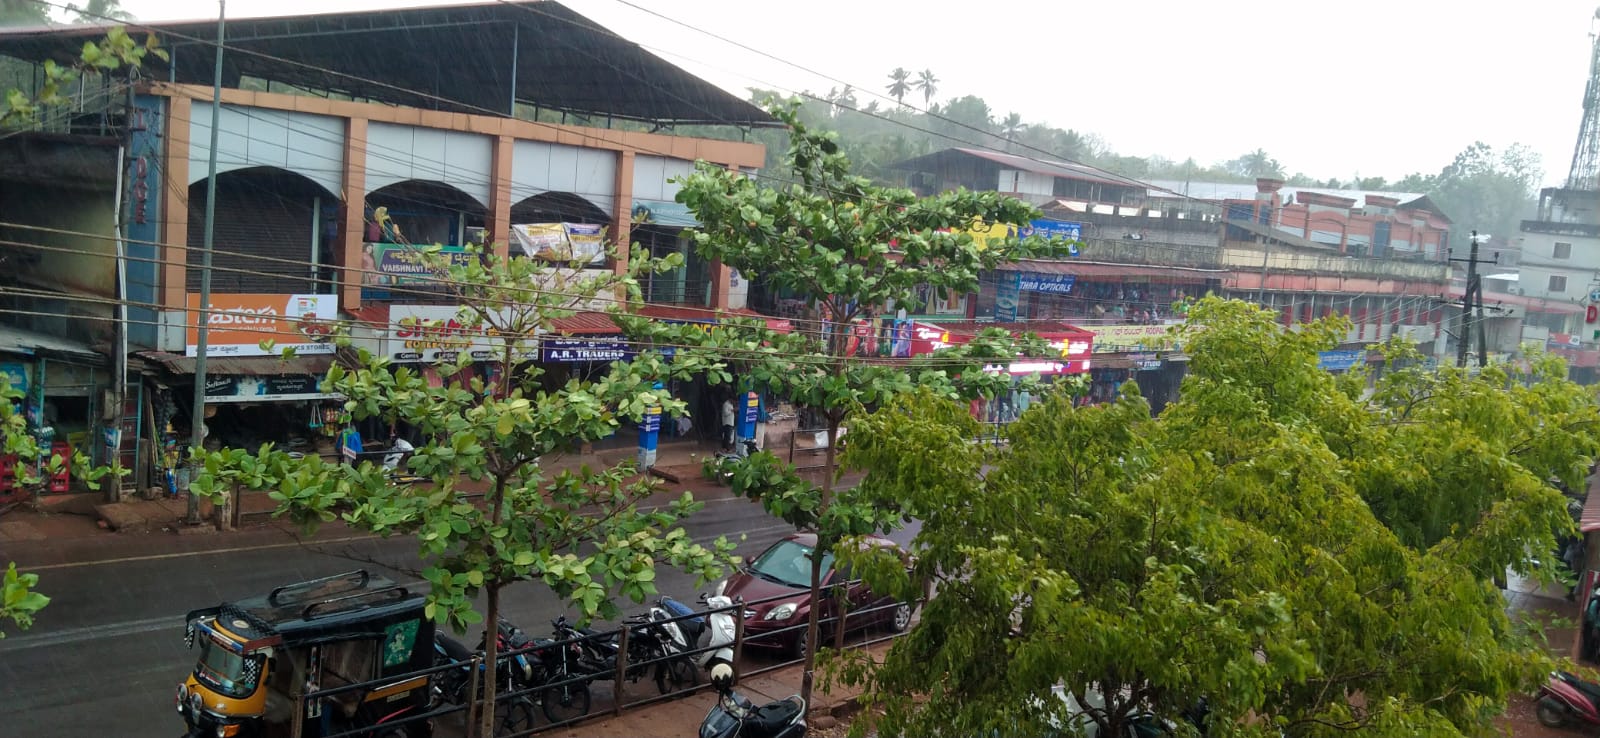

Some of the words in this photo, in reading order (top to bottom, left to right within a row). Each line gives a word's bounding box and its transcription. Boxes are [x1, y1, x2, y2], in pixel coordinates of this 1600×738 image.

[382, 263, 424, 274] VAISHNAVI
[1039, 282, 1072, 292] OPTICALS
[551, 350, 573, 359] A.R.
[575, 350, 625, 358] TRADERS
